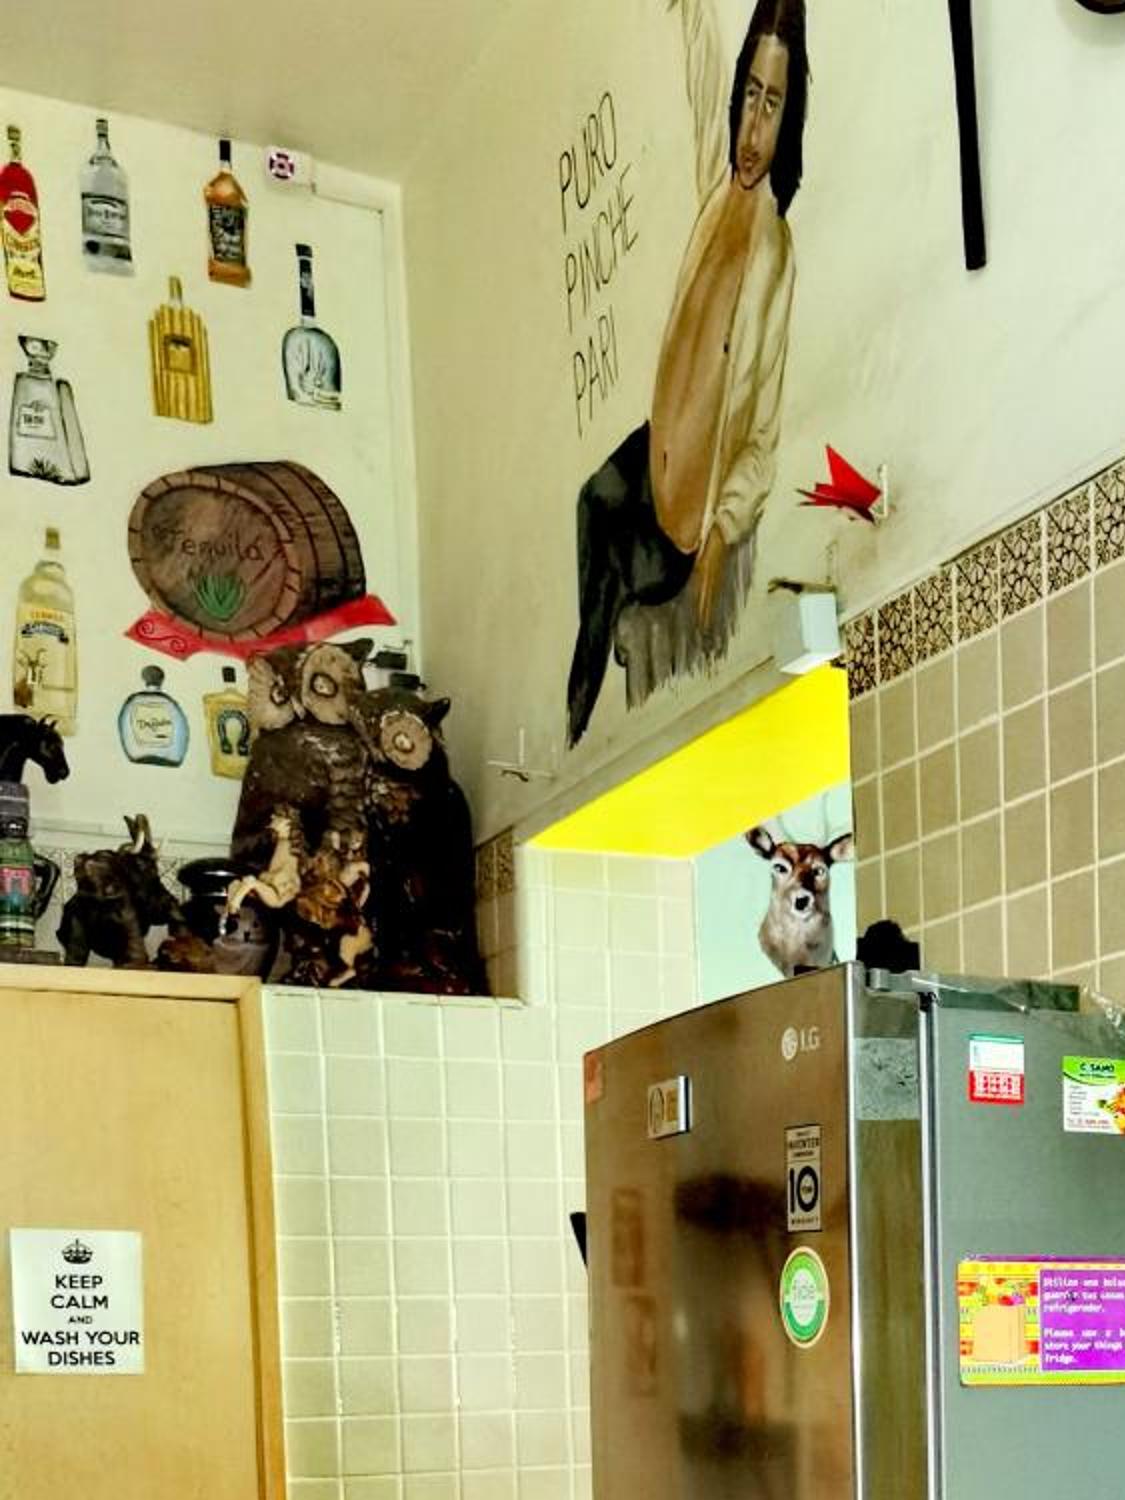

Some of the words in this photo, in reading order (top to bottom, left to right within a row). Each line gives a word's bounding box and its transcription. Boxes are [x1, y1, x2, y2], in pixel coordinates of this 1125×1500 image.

[559, 91, 617, 236] PURO
[565, 162, 639, 336] PINCHE
[573, 304, 619, 440] PARI
[801, 1027, 820, 1051] LG
[55, 1275, 103, 1289] KEEP
[50, 1295, 108, 1309] CALM
[68, 1315, 93, 1324] AND
[21, 1331, 79, 1345] WASH
[85, 1331, 140, 1345] YOUR
[47, 1351, 116, 1366] DISHES
